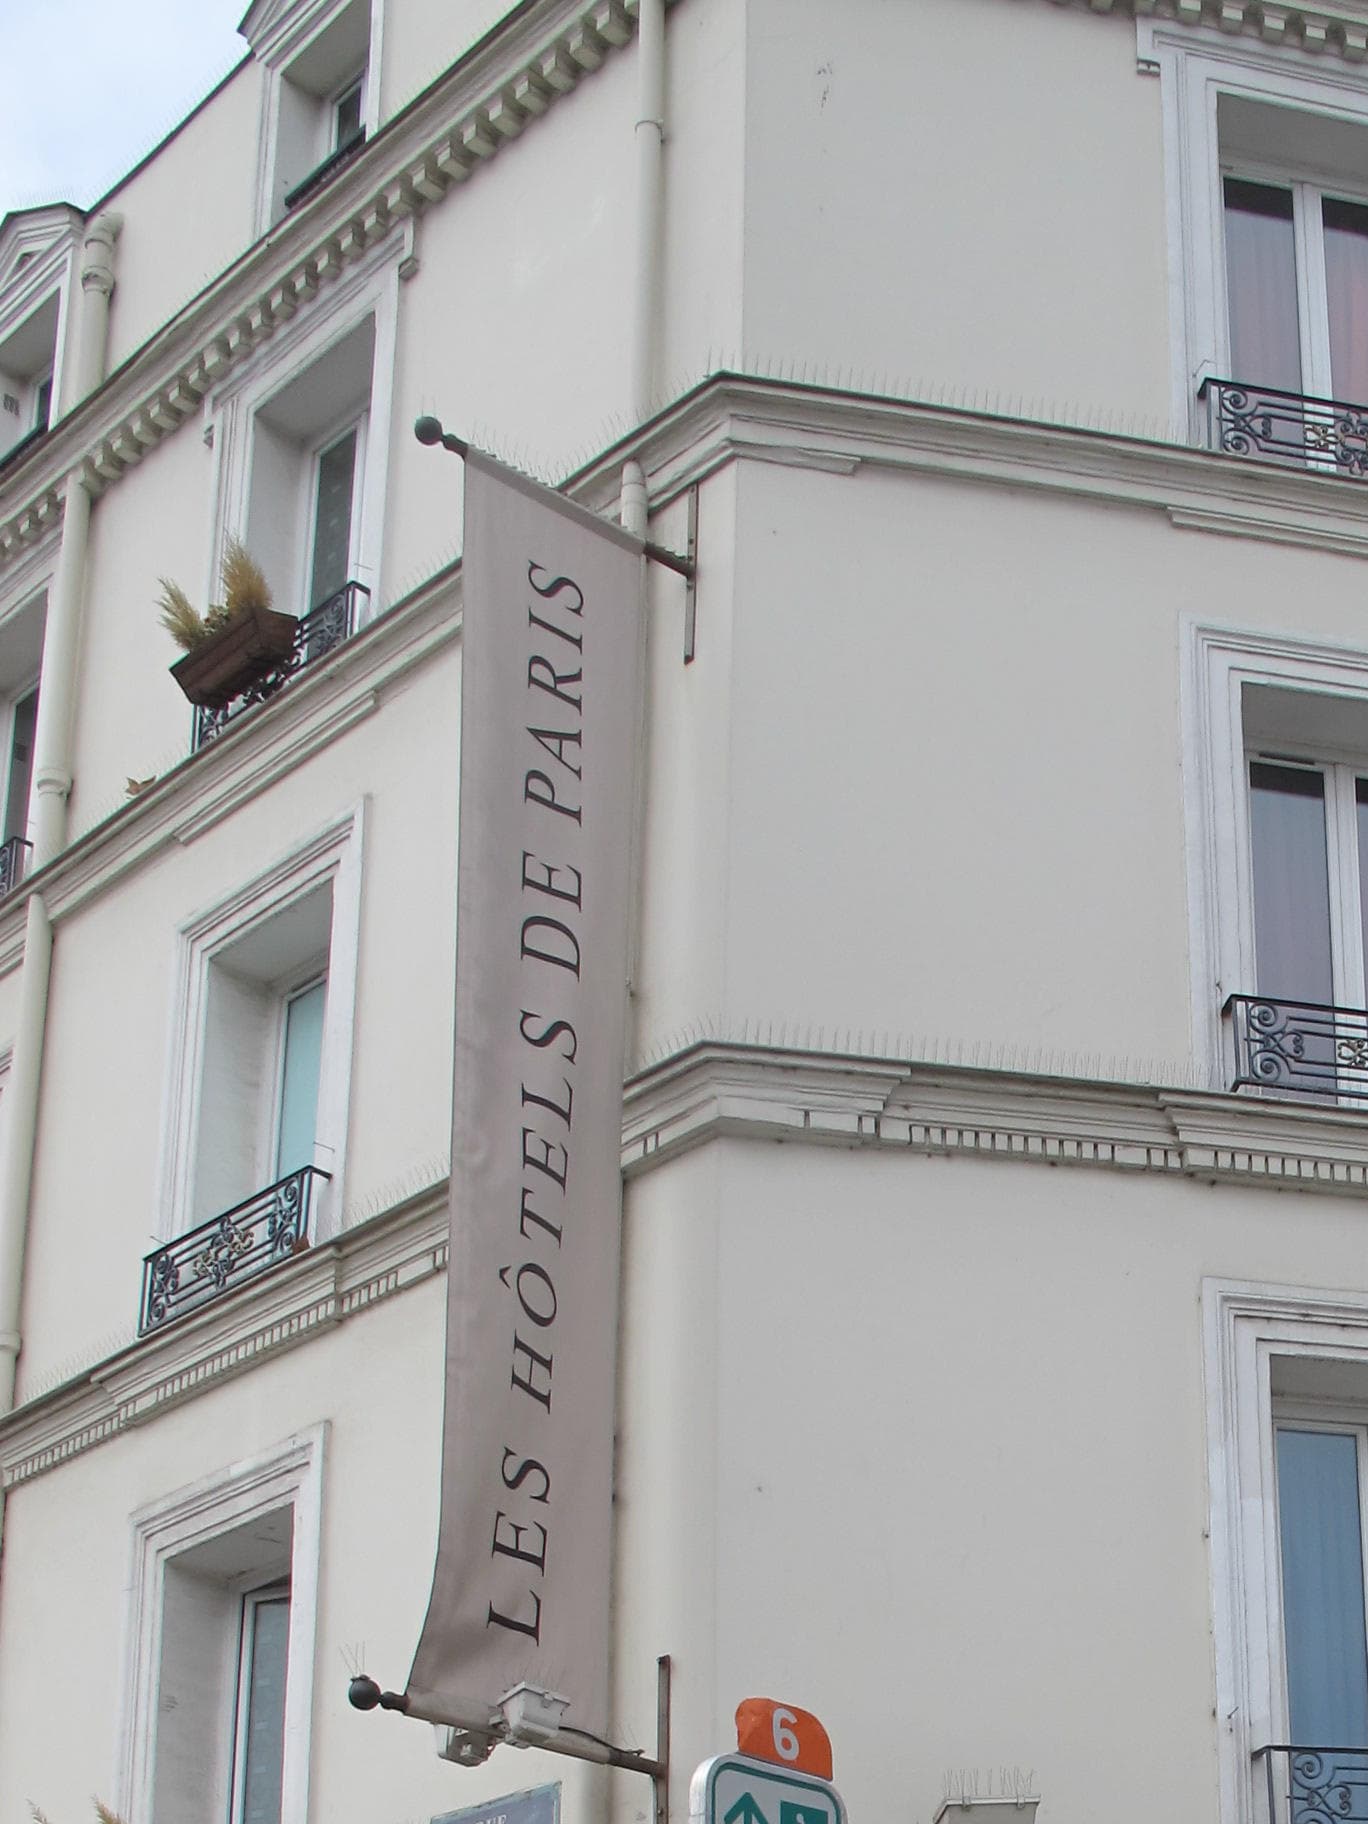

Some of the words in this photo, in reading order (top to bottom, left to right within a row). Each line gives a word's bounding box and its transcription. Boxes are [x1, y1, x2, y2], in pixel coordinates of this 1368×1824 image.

[524, 558, 586, 827] PARIS
[519, 849, 584, 983] DE
[498, 1008, 579, 1414] HÔTELS
[486, 1446, 552, 1647] LES
[772, 1707, 800, 1761] 6
